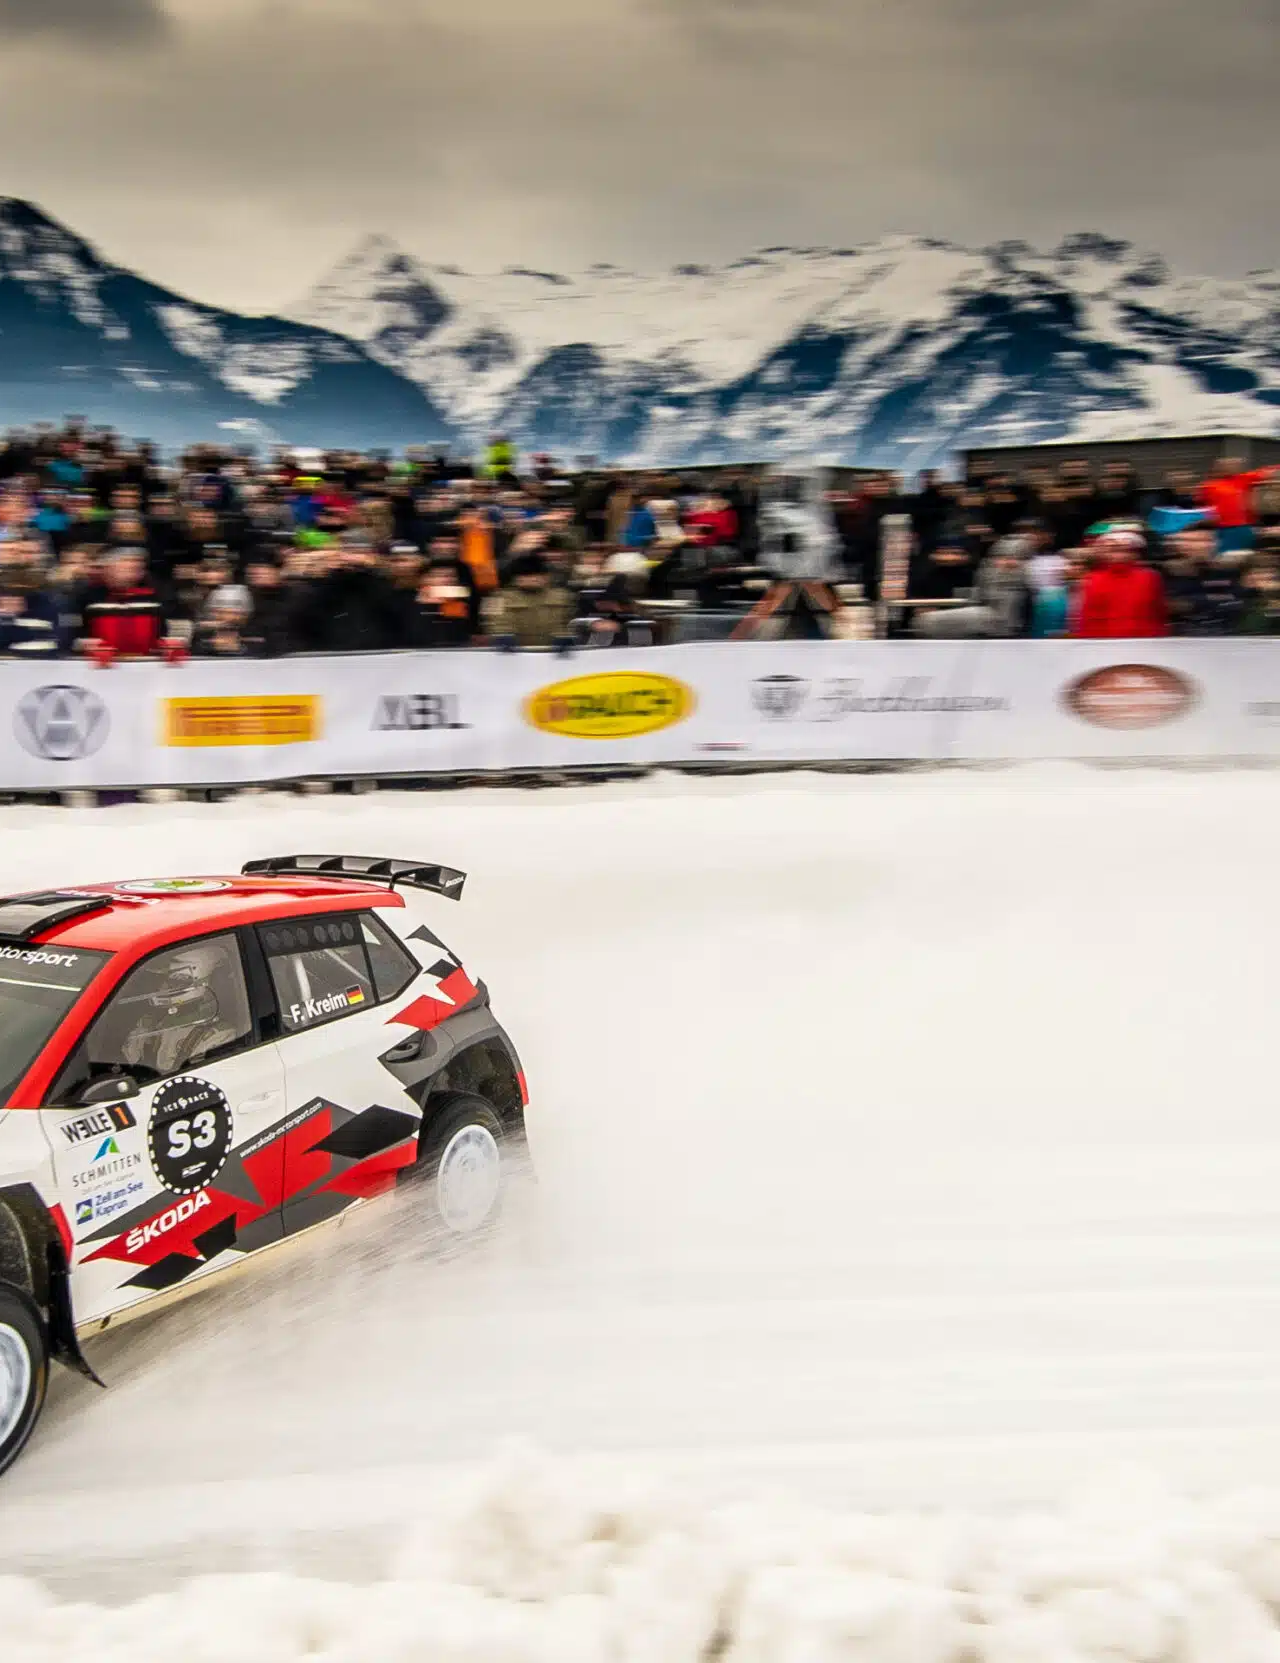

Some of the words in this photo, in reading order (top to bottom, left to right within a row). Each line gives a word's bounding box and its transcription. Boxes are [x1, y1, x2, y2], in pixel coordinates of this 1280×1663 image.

[290, 1003, 306, 1024] F.
[303, 993, 348, 1019] Kreim
[61, 1112, 112, 1143] WELLE
[114, 1106, 129, 1126] 1
[167, 1110, 216, 1158] S3
[72, 1152, 141, 1188] SCHMITTEN
[127, 1181, 143, 1194] See
[125, 1190, 212, 1255] ŠKODA
